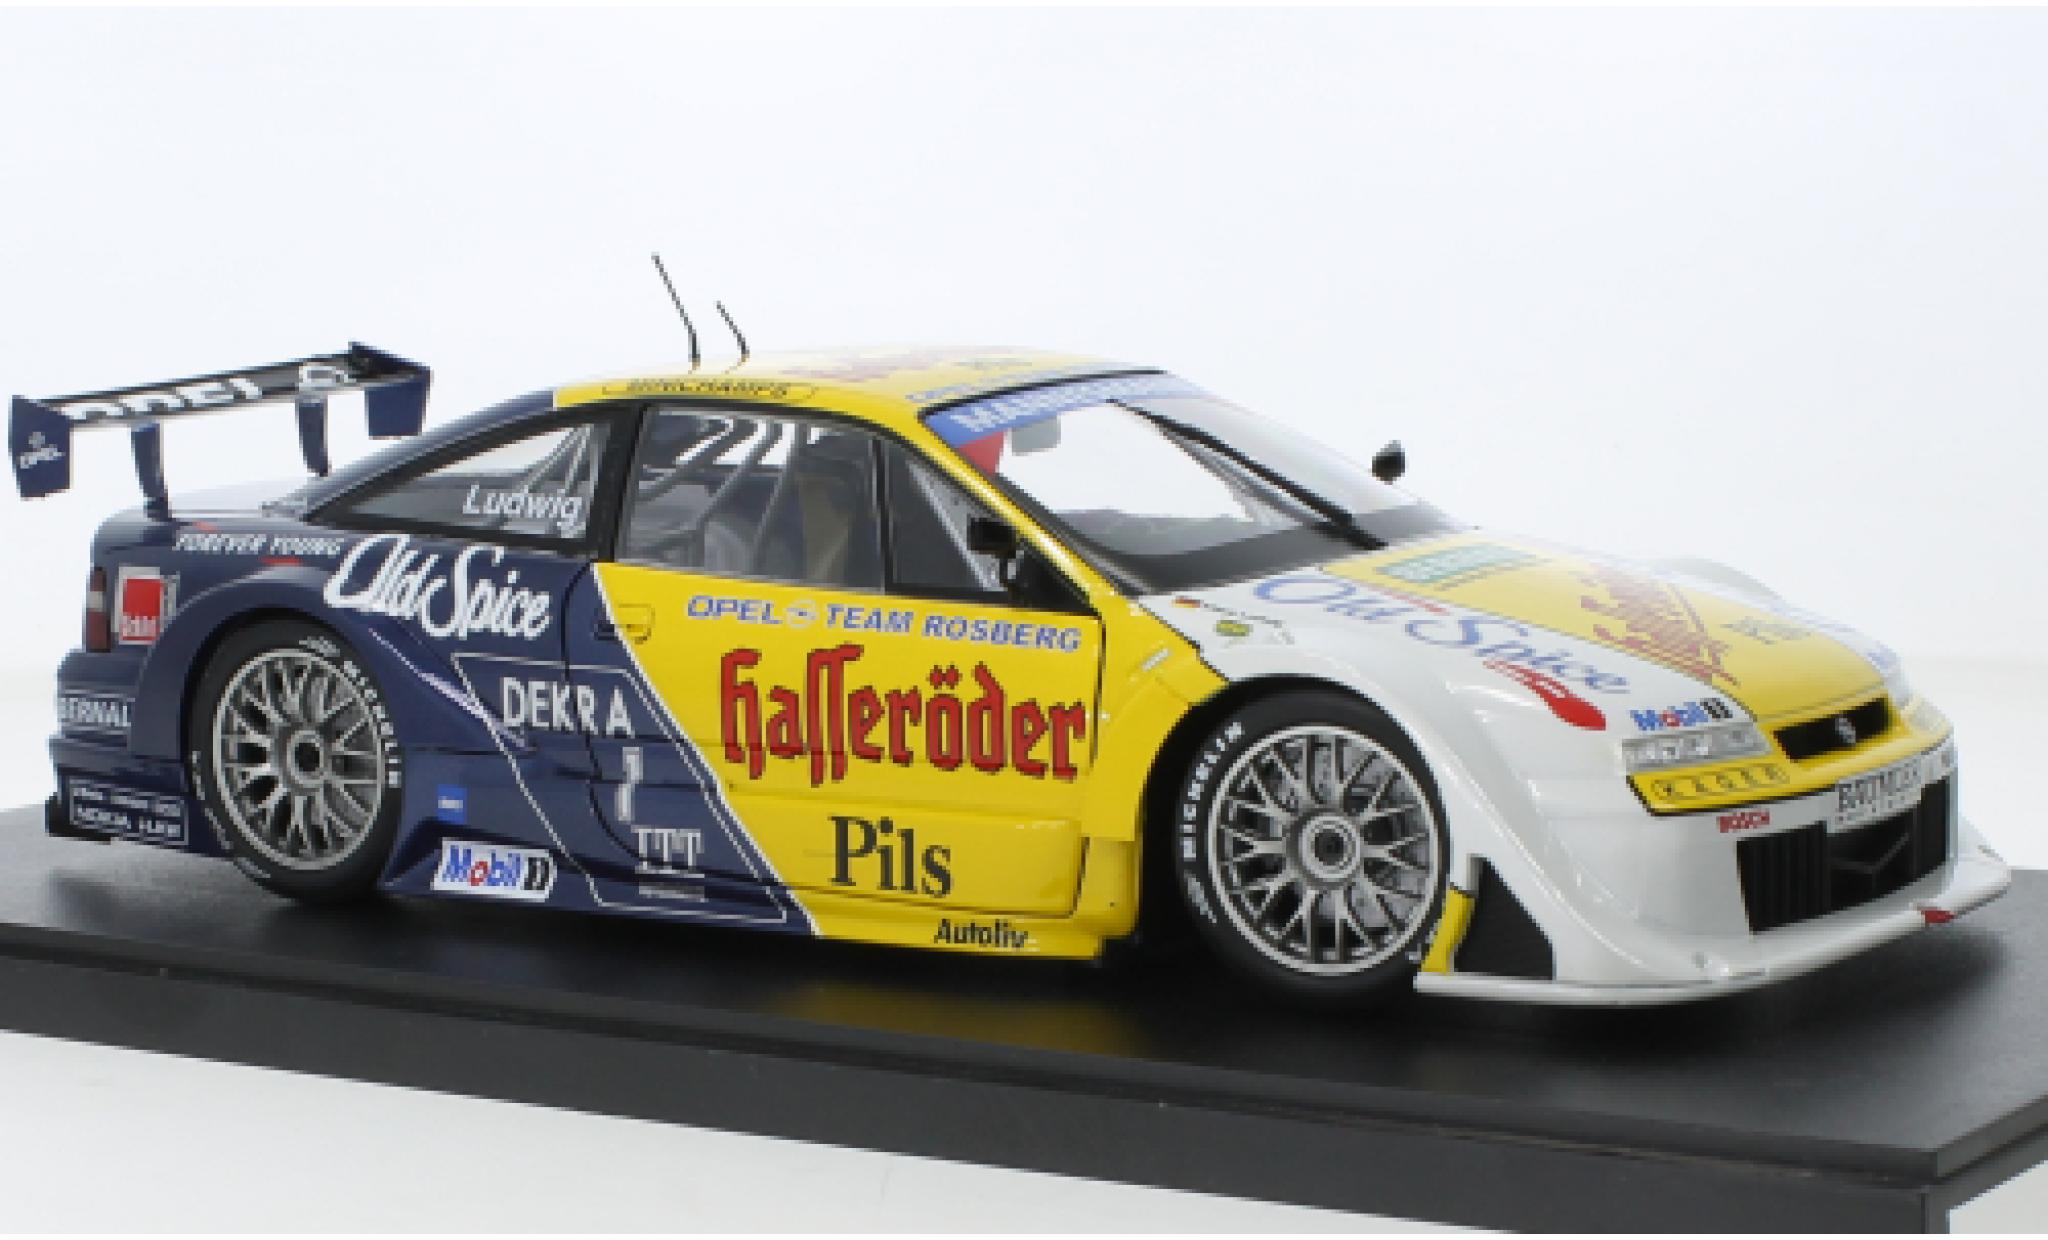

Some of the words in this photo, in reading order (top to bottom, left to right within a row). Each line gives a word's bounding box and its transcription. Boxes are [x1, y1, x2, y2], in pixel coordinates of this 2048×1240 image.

[463, 484, 584, 537] Ludwig
[324, 534, 444, 618] Old
[422, 544, 550, 639] Spice
[687, 594, 783, 622] OPEL
[826, 603, 912, 633] TEAM
[924, 610, 1082, 652] ROSBERG
[503, 678, 635, 738] DEKRA
[441, 844, 522, 887] Mobil
[829, 815, 955, 899] Pils
[933, 918, 1029, 950] Autoliv
